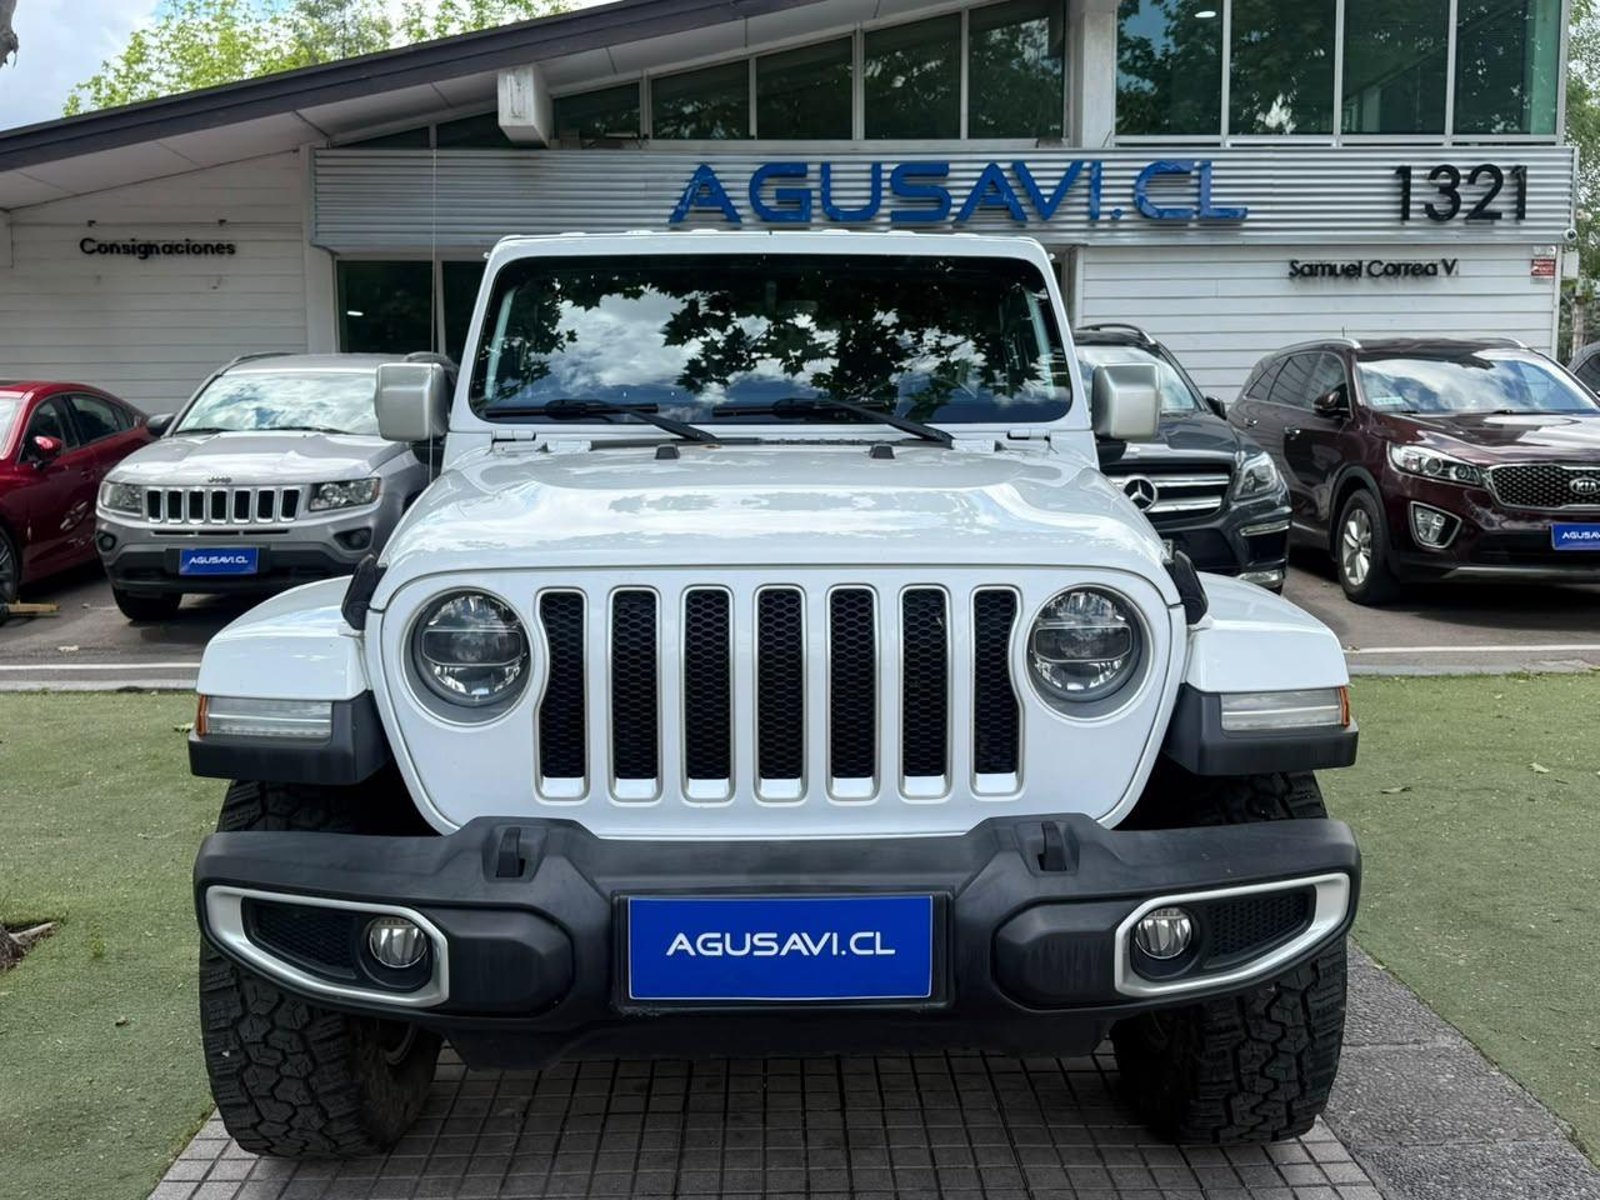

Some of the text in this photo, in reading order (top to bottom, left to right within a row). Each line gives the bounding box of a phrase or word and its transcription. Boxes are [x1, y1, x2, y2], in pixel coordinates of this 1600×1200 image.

[669, 160, 1248, 223] AGUSAVI.CL
[1395, 164, 1527, 221] 1321
[79, 237, 236, 260] Consignaciones
[1289, 260, 1363, 278] Samuel
[1367, 259, 1438, 278] Correa
[666, 932, 896, 956] AGUSAVI.CL
